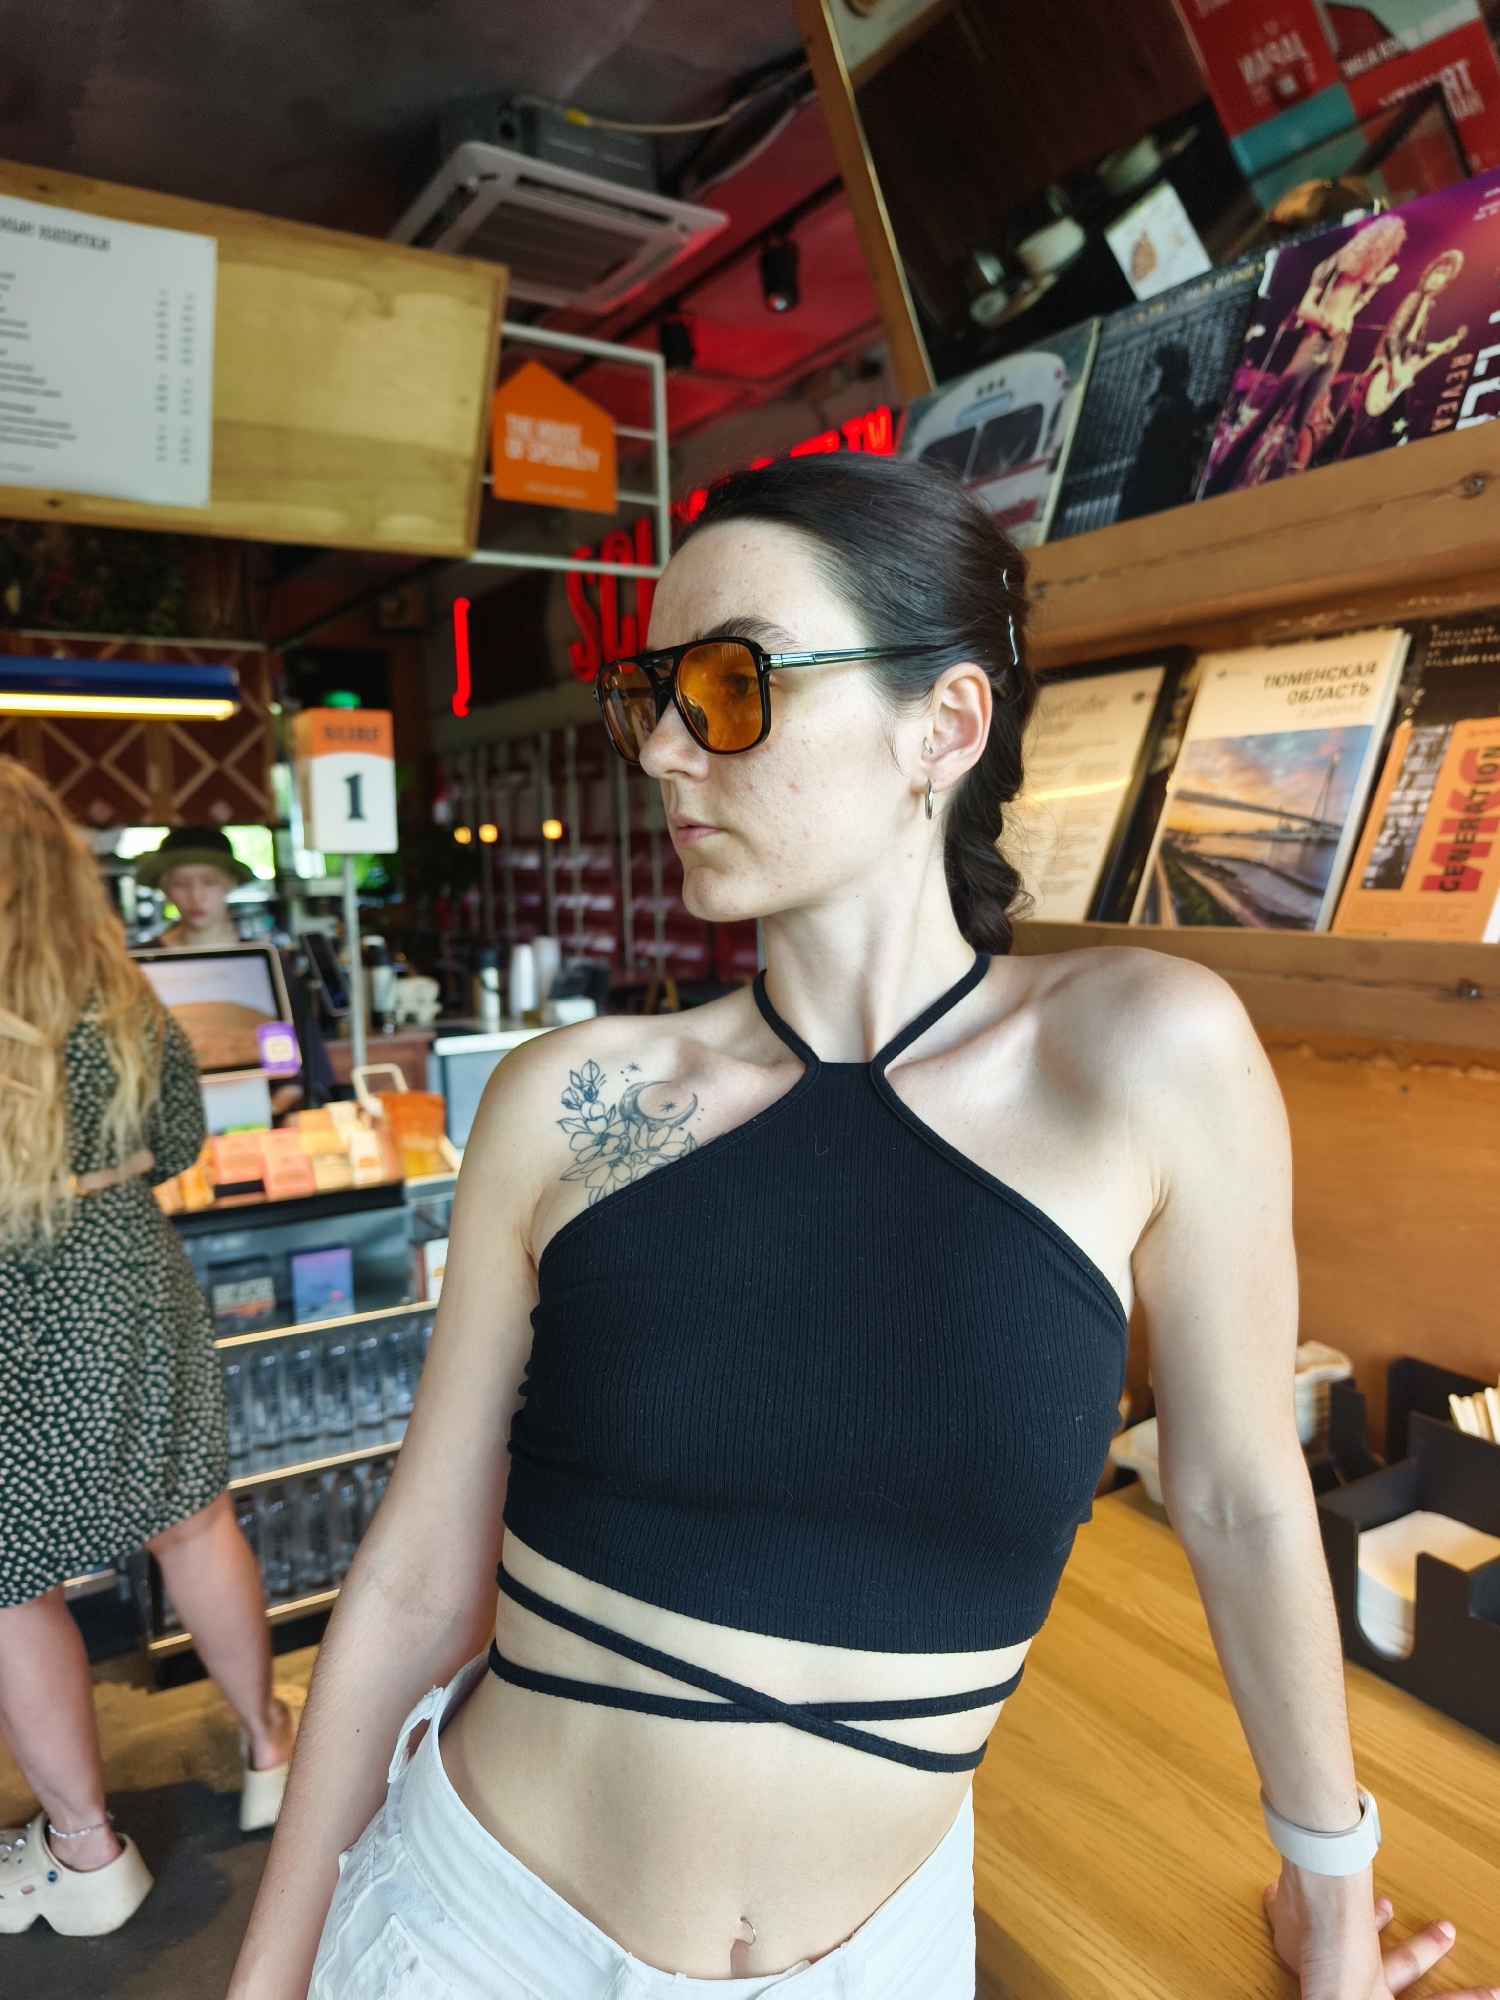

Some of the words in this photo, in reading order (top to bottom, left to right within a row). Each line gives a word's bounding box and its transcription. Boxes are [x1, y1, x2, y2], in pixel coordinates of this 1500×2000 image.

[1263, 660, 1377, 690] ТЮМЕНСКАЯ
[1286, 681, 1370, 705] ОБЛАСТЬ
[343, 772, 367, 822] 1
[1439, 745, 1500, 892] GENERATION
